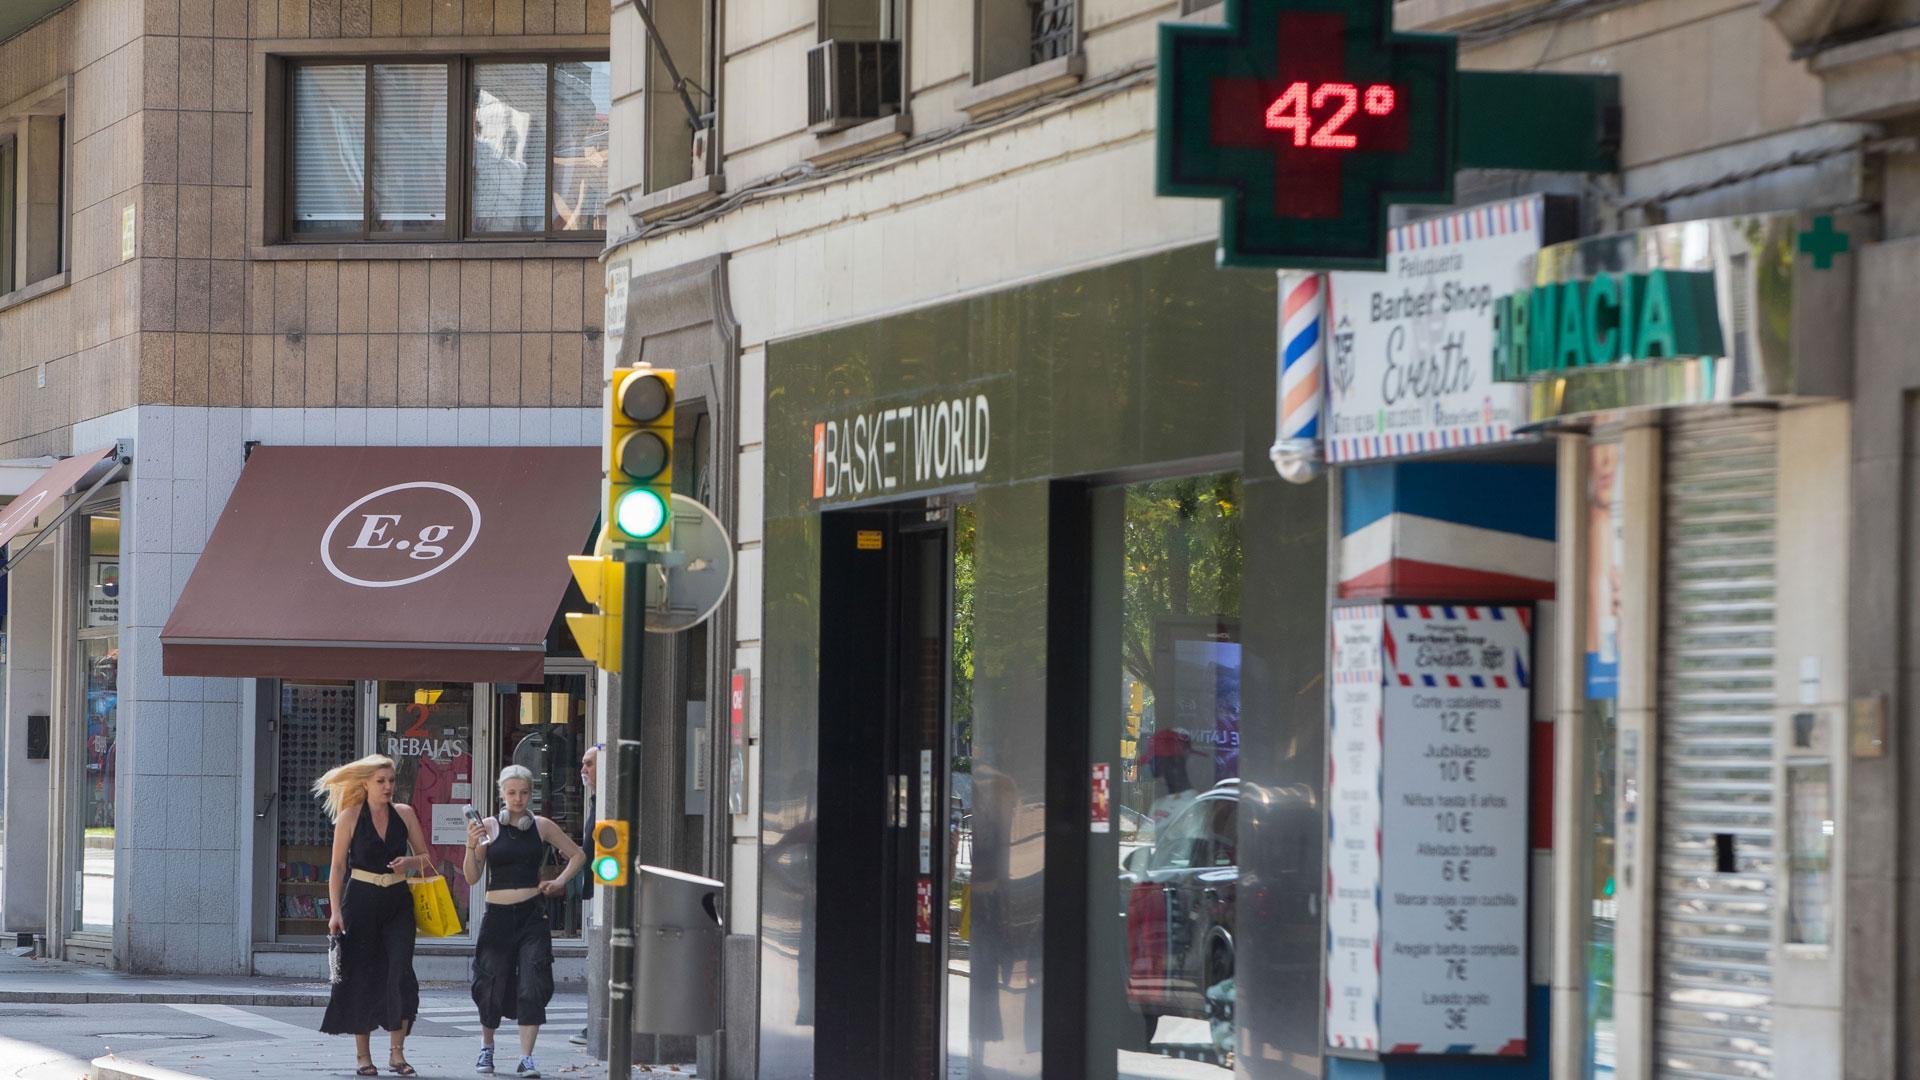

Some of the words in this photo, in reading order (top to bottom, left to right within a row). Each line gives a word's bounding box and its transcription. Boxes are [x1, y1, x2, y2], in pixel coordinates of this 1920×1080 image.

[1371, 287, 1437, 322] Barber
[1441, 281, 1492, 317] Shop
[1381, 324, 1475, 405] Everth
[346, 514, 454, 560] E.g
[1440, 711, 1460, 733] 12
[1463, 711, 1477, 733] €
[387, 737, 462, 760] REBAJAS
[1439, 760, 1460, 783] 10
[1463, 760, 1477, 783] €
[1435, 811, 1457, 834] 10
[1459, 811, 1474, 834] €
[1458, 860, 1472, 882] €
